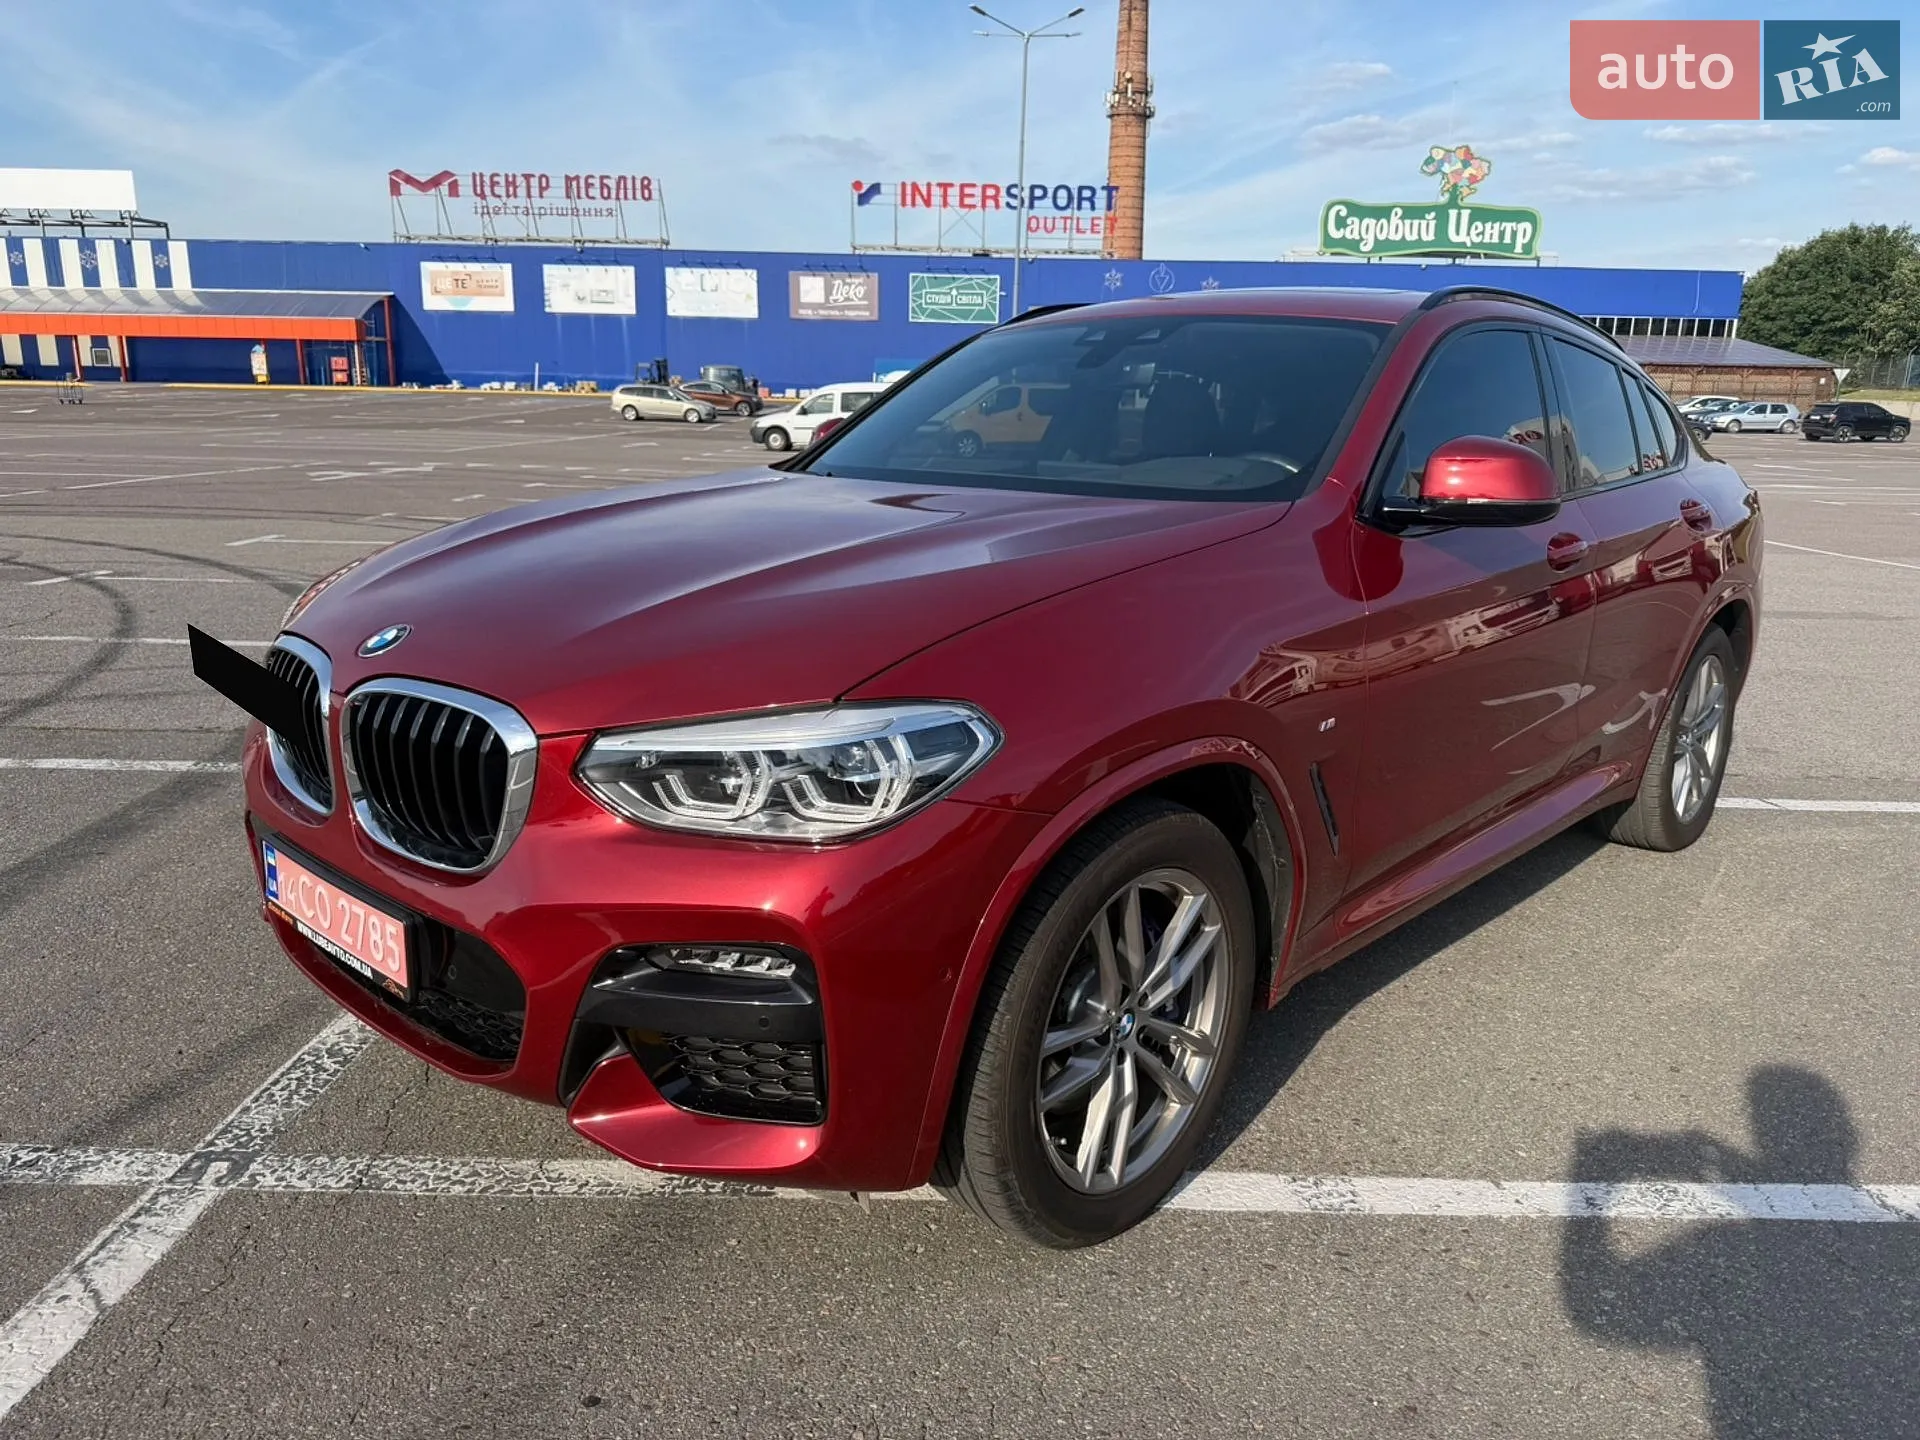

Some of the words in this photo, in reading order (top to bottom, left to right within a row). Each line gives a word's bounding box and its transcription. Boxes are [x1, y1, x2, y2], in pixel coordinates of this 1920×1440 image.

[471, 171, 550, 200] ЦЕНТР
[564, 173, 653, 202] МЕБЛІВ
[899, 181, 1120, 212] INTERSPORT
[1026, 215, 1119, 235] OUTLET
[1327, 204, 1437, 252] Садовий
[1448, 208, 1533, 253] Центр
[337, 897, 401, 973] 2785
